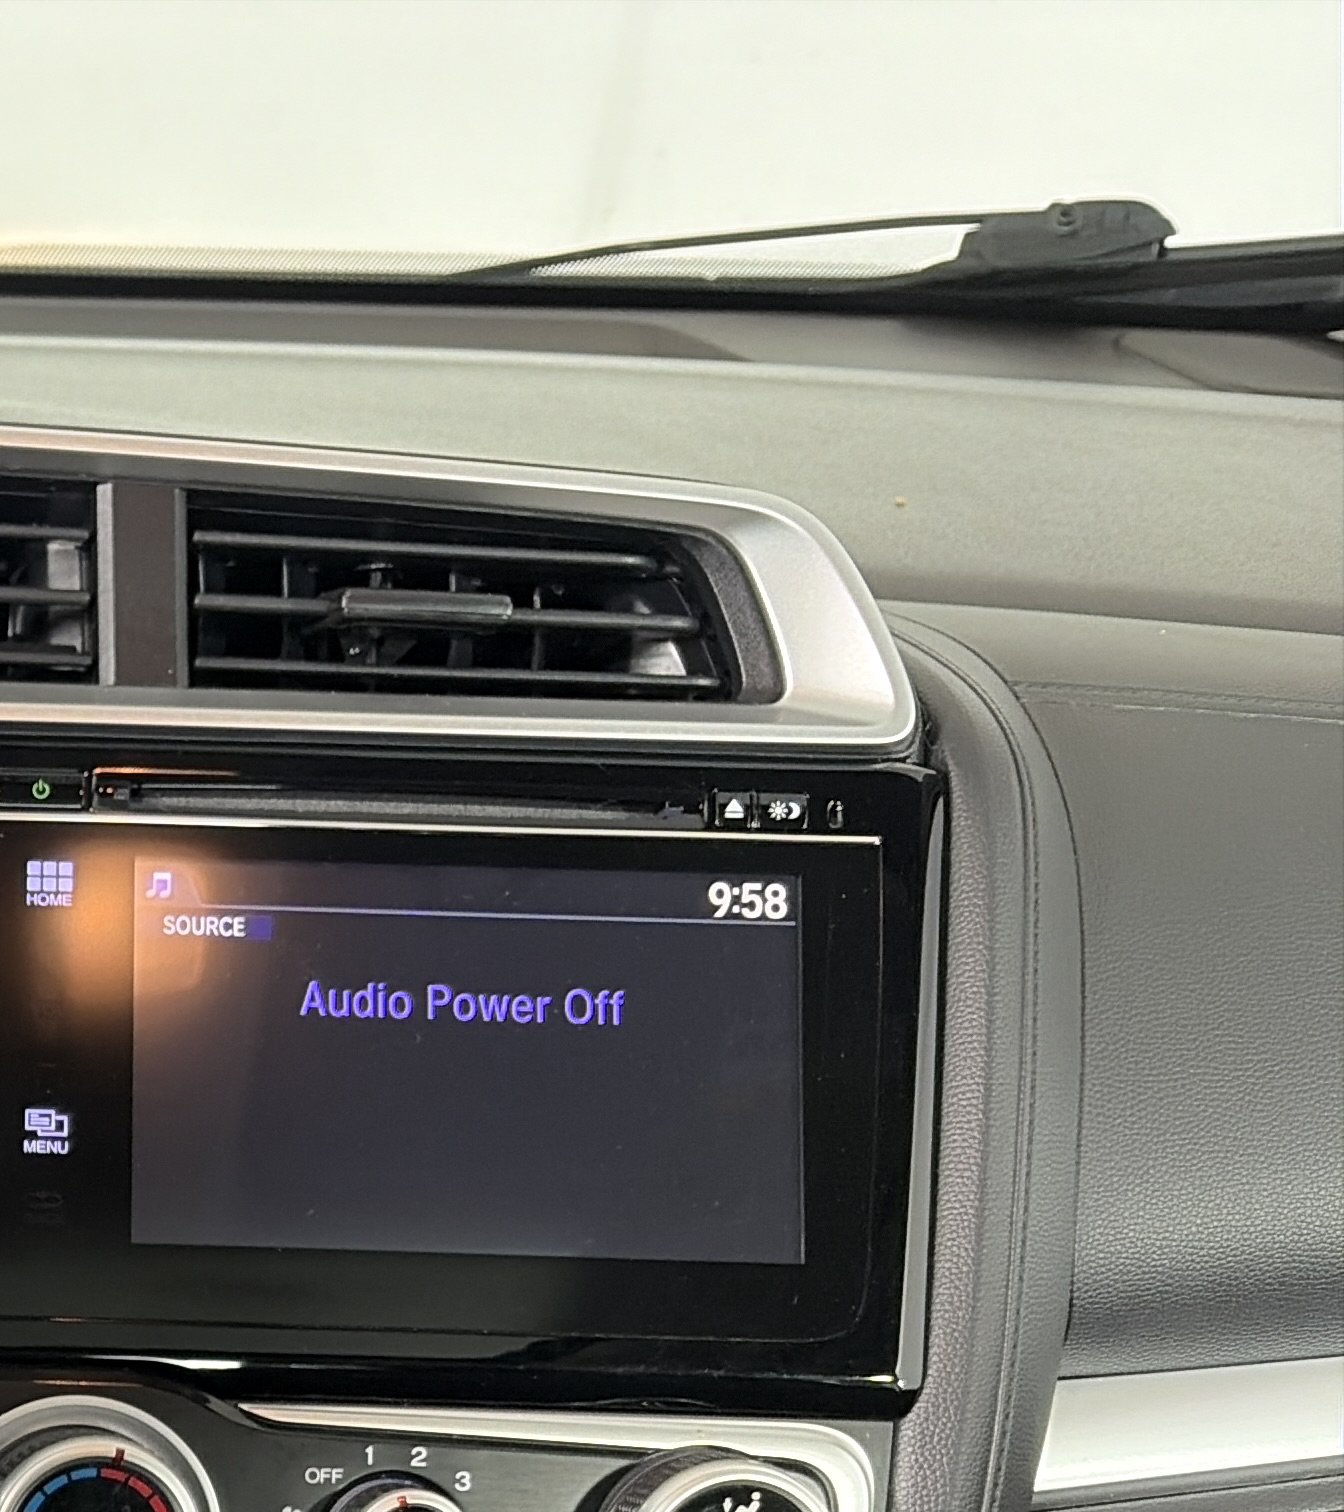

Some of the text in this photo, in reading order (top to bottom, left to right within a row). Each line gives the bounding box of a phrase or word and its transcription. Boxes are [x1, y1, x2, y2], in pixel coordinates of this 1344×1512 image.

[25, 893, 72, 907] HOME
[708, 882, 788, 920] 9:58
[162, 915, 247, 938] SOURCE
[299, 980, 626, 1027] Audio Power Off
[23, 1139, 70, 1155] MENU
[364, 1445, 375, 1466] 1
[409, 1446, 428, 1468] 2
[304, 1466, 344, 1486] OFF
[454, 1471, 473, 1492] 3
